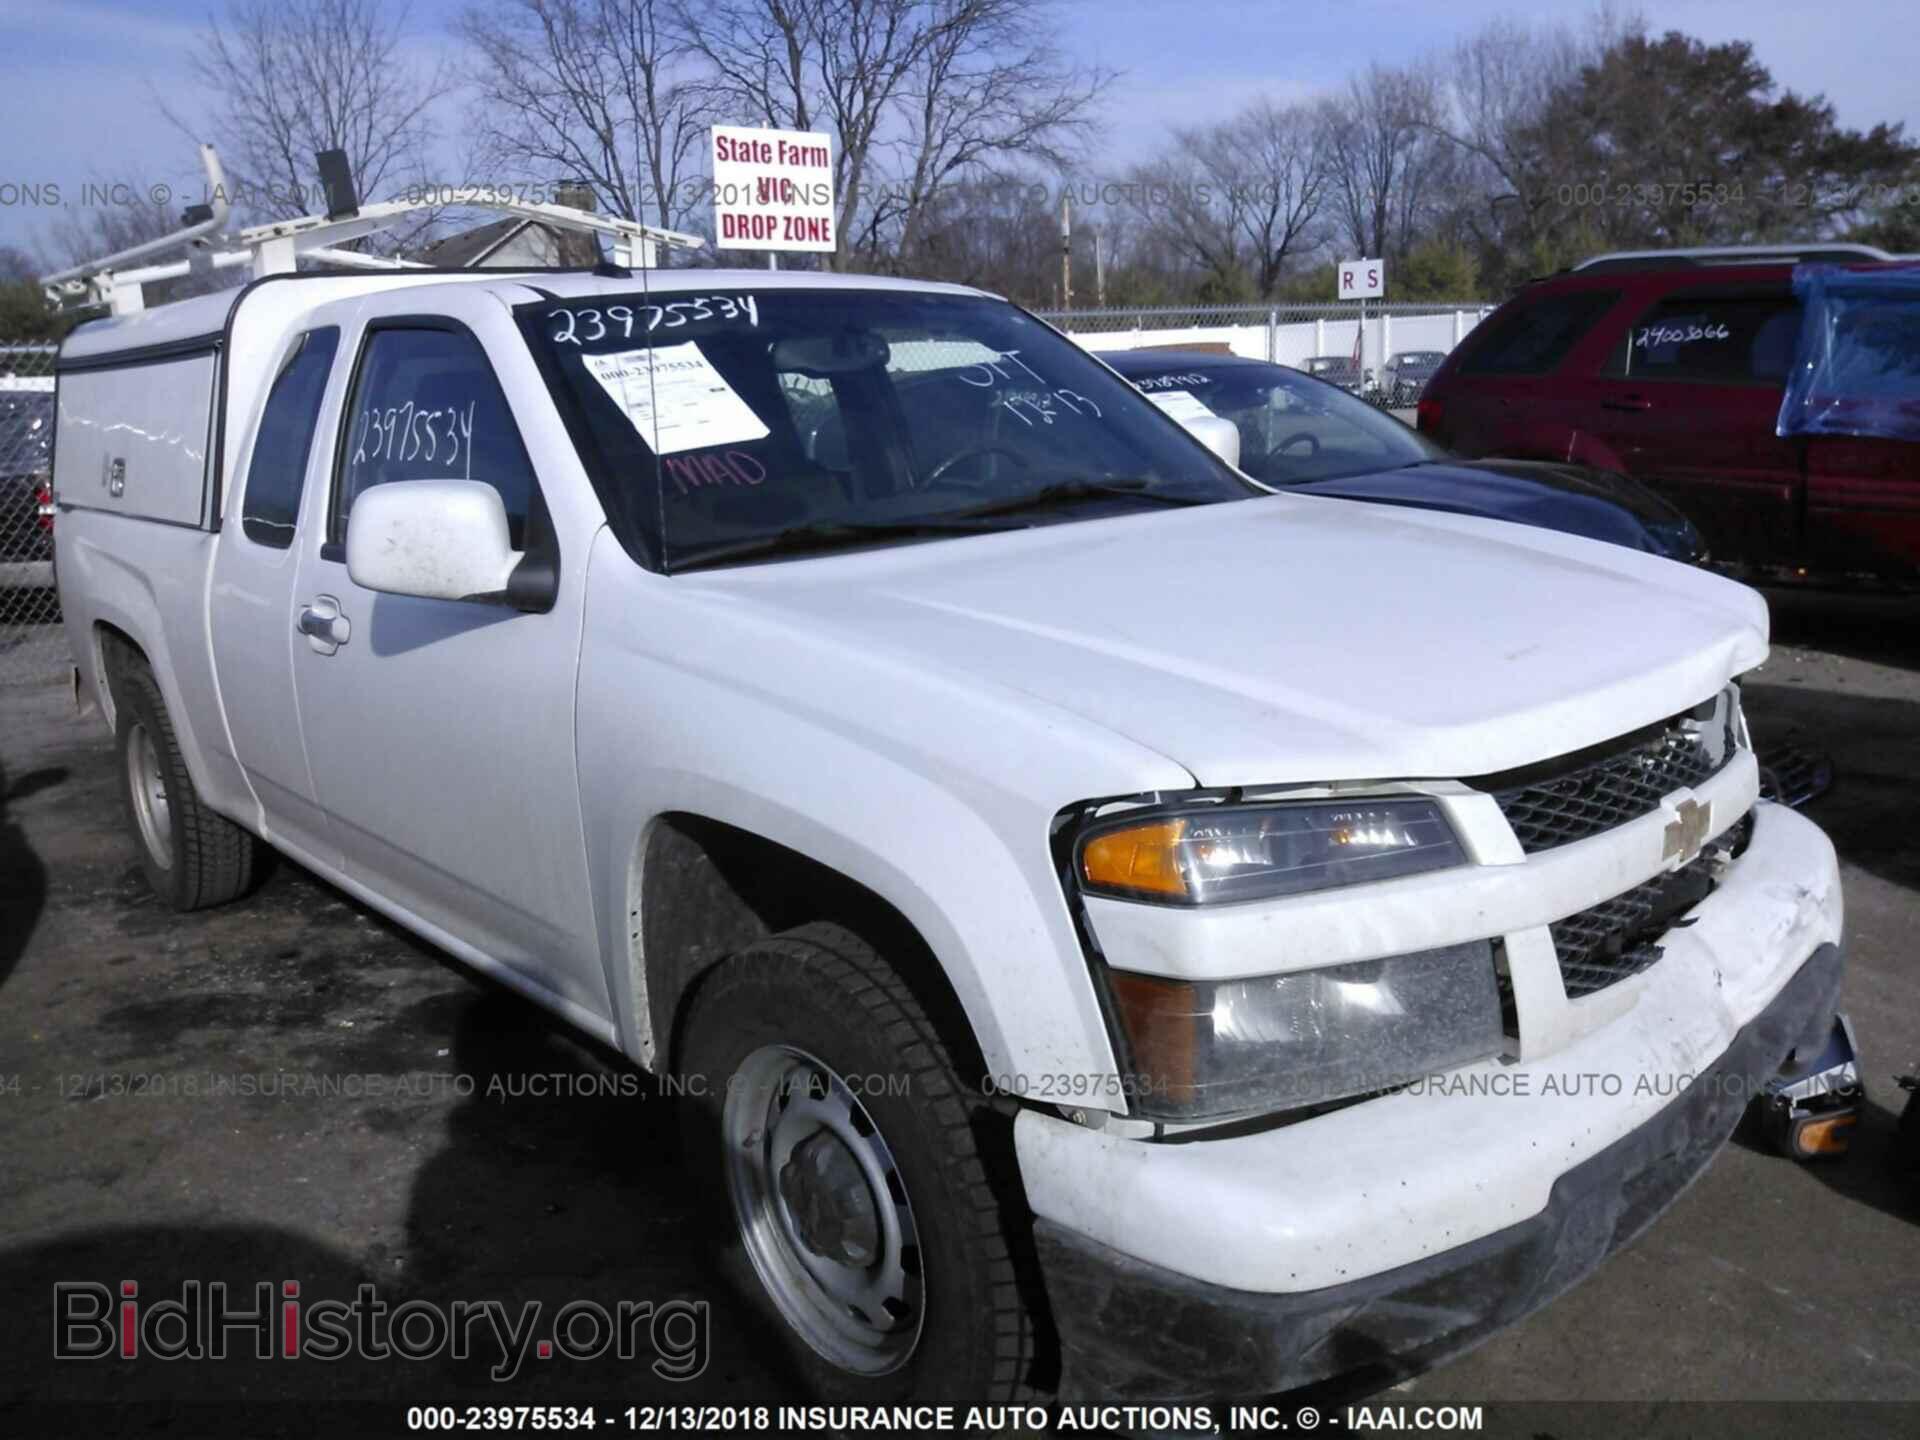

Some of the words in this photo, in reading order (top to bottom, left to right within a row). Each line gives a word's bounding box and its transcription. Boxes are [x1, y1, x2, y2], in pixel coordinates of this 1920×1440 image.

[716, 135, 772, 164] State
[778, 139, 828, 168] Farm
[757, 176, 792, 204] VIC
[722, 213, 777, 240] DROP
[783, 215, 831, 242] ZONE
[1343, 271, 1354, 290] R
[1367, 269, 1378, 288] S
[548, 295, 759, 346] 23975534
[352, 399, 476, 480] 23975534
